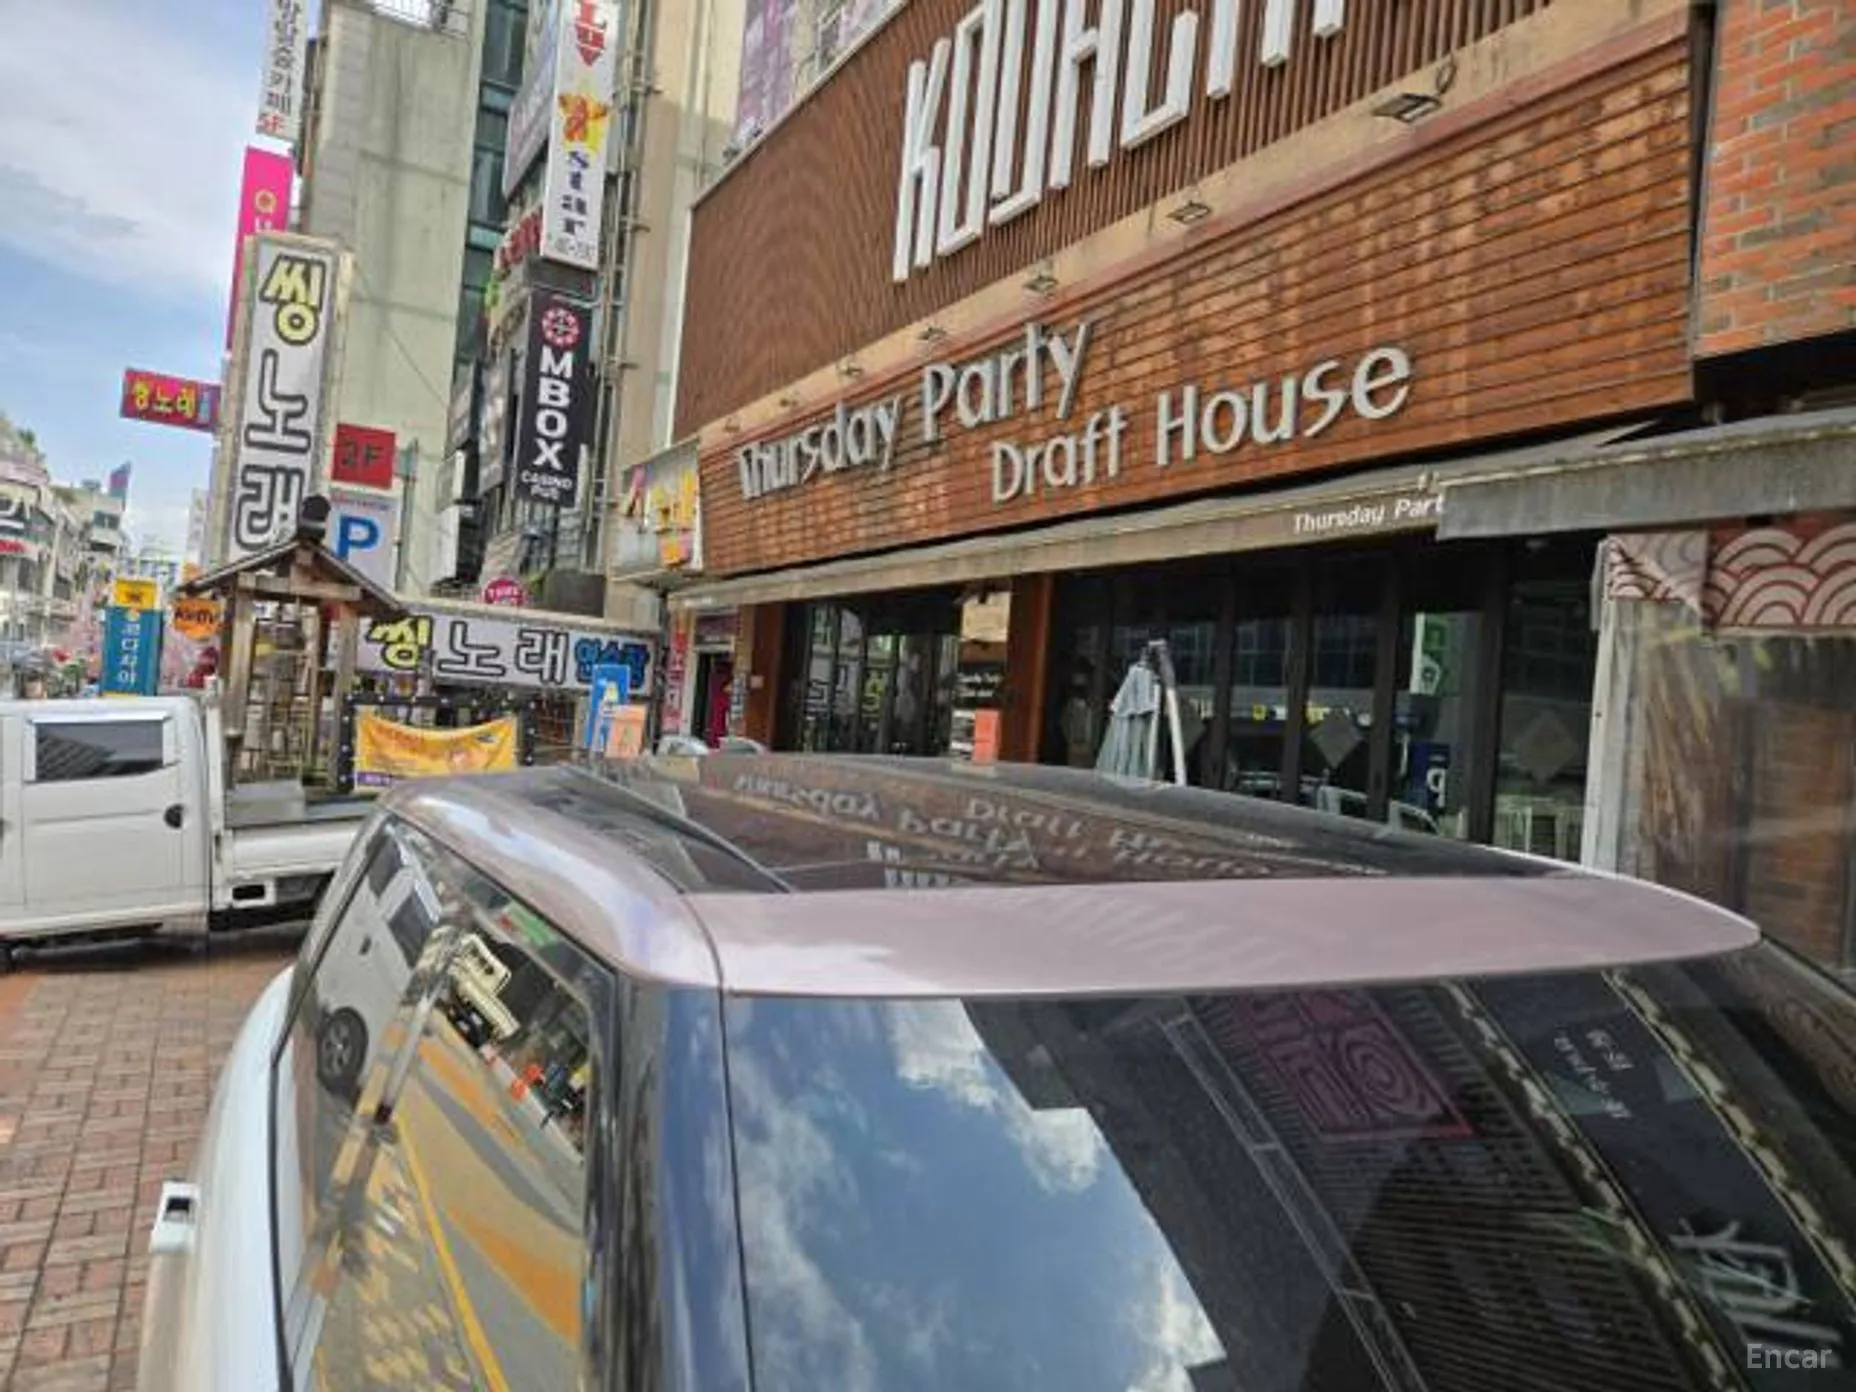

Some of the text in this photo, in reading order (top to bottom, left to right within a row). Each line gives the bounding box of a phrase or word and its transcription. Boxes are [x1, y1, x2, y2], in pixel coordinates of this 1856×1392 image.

[532, 345, 574, 471] MBOX
[740, 320, 1094, 500] Thursday Party
[992, 346, 1411, 502] Draft House
[335, 516, 380, 560] P
[1295, 494, 1445, 534] Thursday Part
